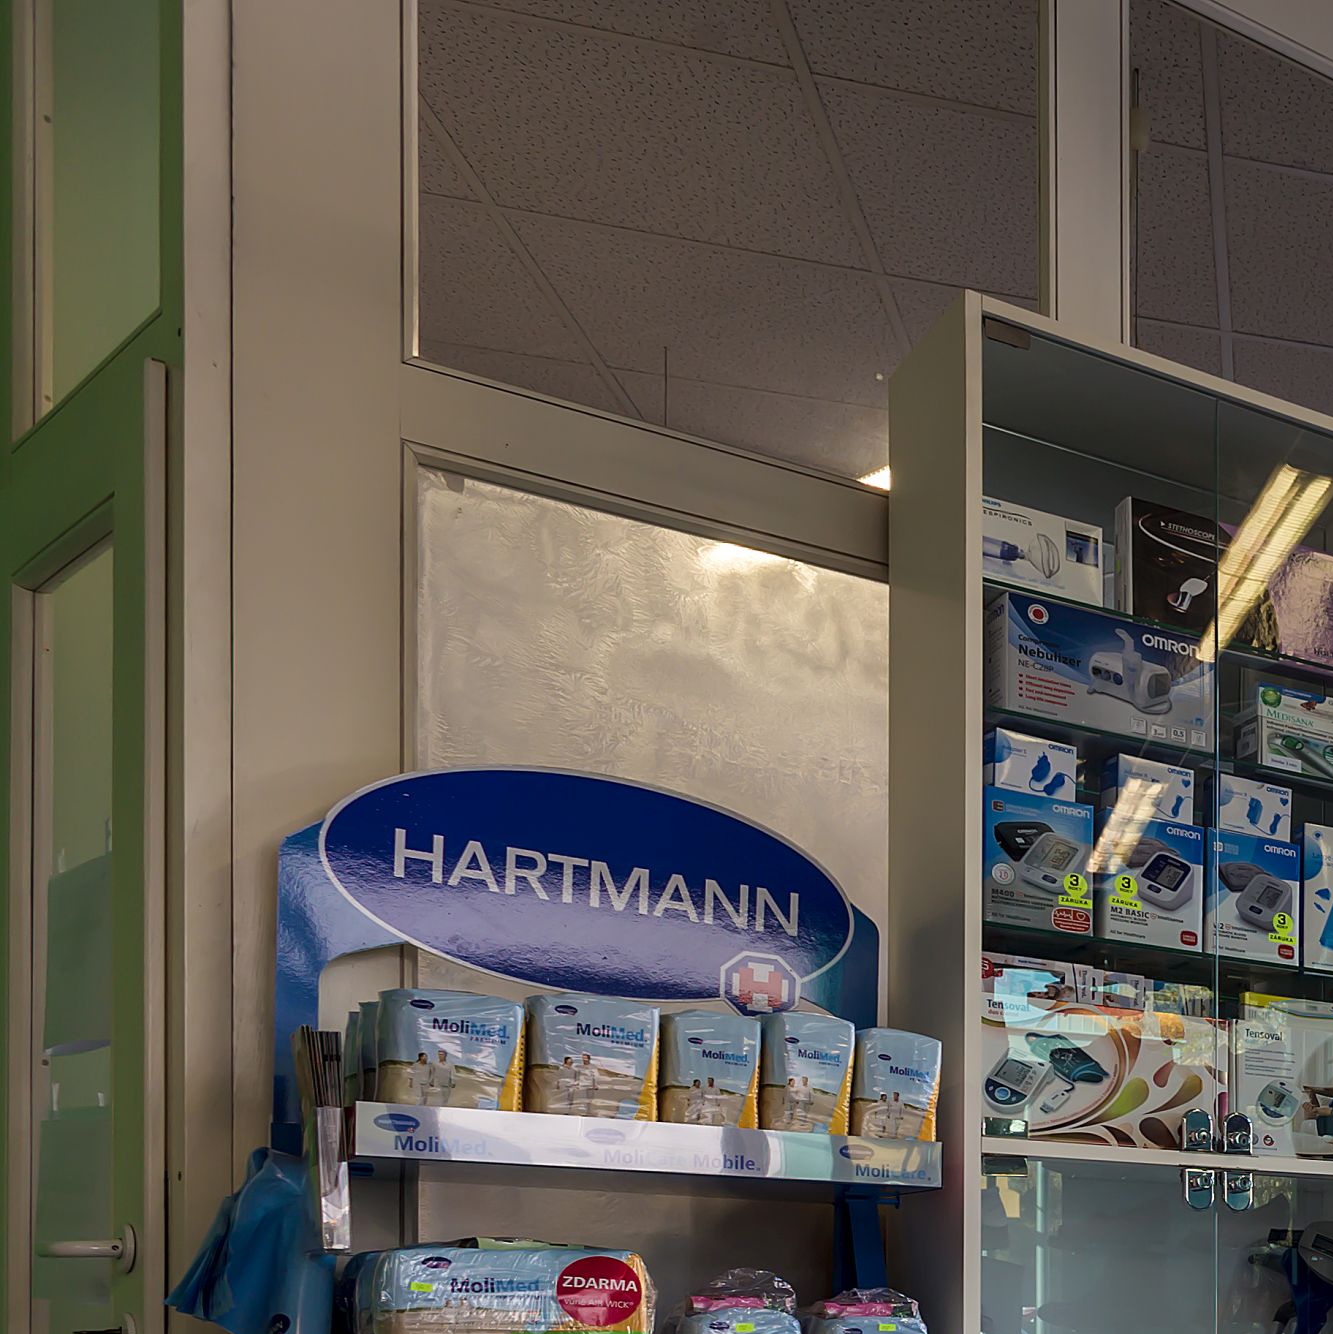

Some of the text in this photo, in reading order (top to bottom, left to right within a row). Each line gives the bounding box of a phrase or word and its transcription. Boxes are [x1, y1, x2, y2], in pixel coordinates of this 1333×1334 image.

[983, 509, 1033, 526] ESPIRONICS
[1018, 643, 1082, 669] Nebulizer
[1266, 708, 1314, 728] MEDISANA
[1048, 743, 1074, 754] OMRON
[1266, 786, 1289, 796] OMRON
[1052, 804, 1090, 819] OMRON
[1166, 826, 1201, 841] OMRON
[1263, 844, 1297, 857] OMRON
[393, 826, 800, 938] HARTMANN
[1069, 874, 1079, 887] 3
[1121, 877, 1131, 889] 3
[1060, 896, 1089, 906] ZÁRUKA
[1111, 897, 1138, 908] ZÁRUKA
[1110, 905, 1123, 915] M2
[1125, 908, 1149, 919] BASIC
[1277, 914, 1286, 925] 3
[1269, 933, 1293, 943] ZÁRUKA
[987, 999, 1030, 1012] Tensoval
[1245, 1028, 1283, 1041] Tensoval
[562, 1275, 638, 1293] ZDARMA
[588, 1298, 606, 1309] AIR
